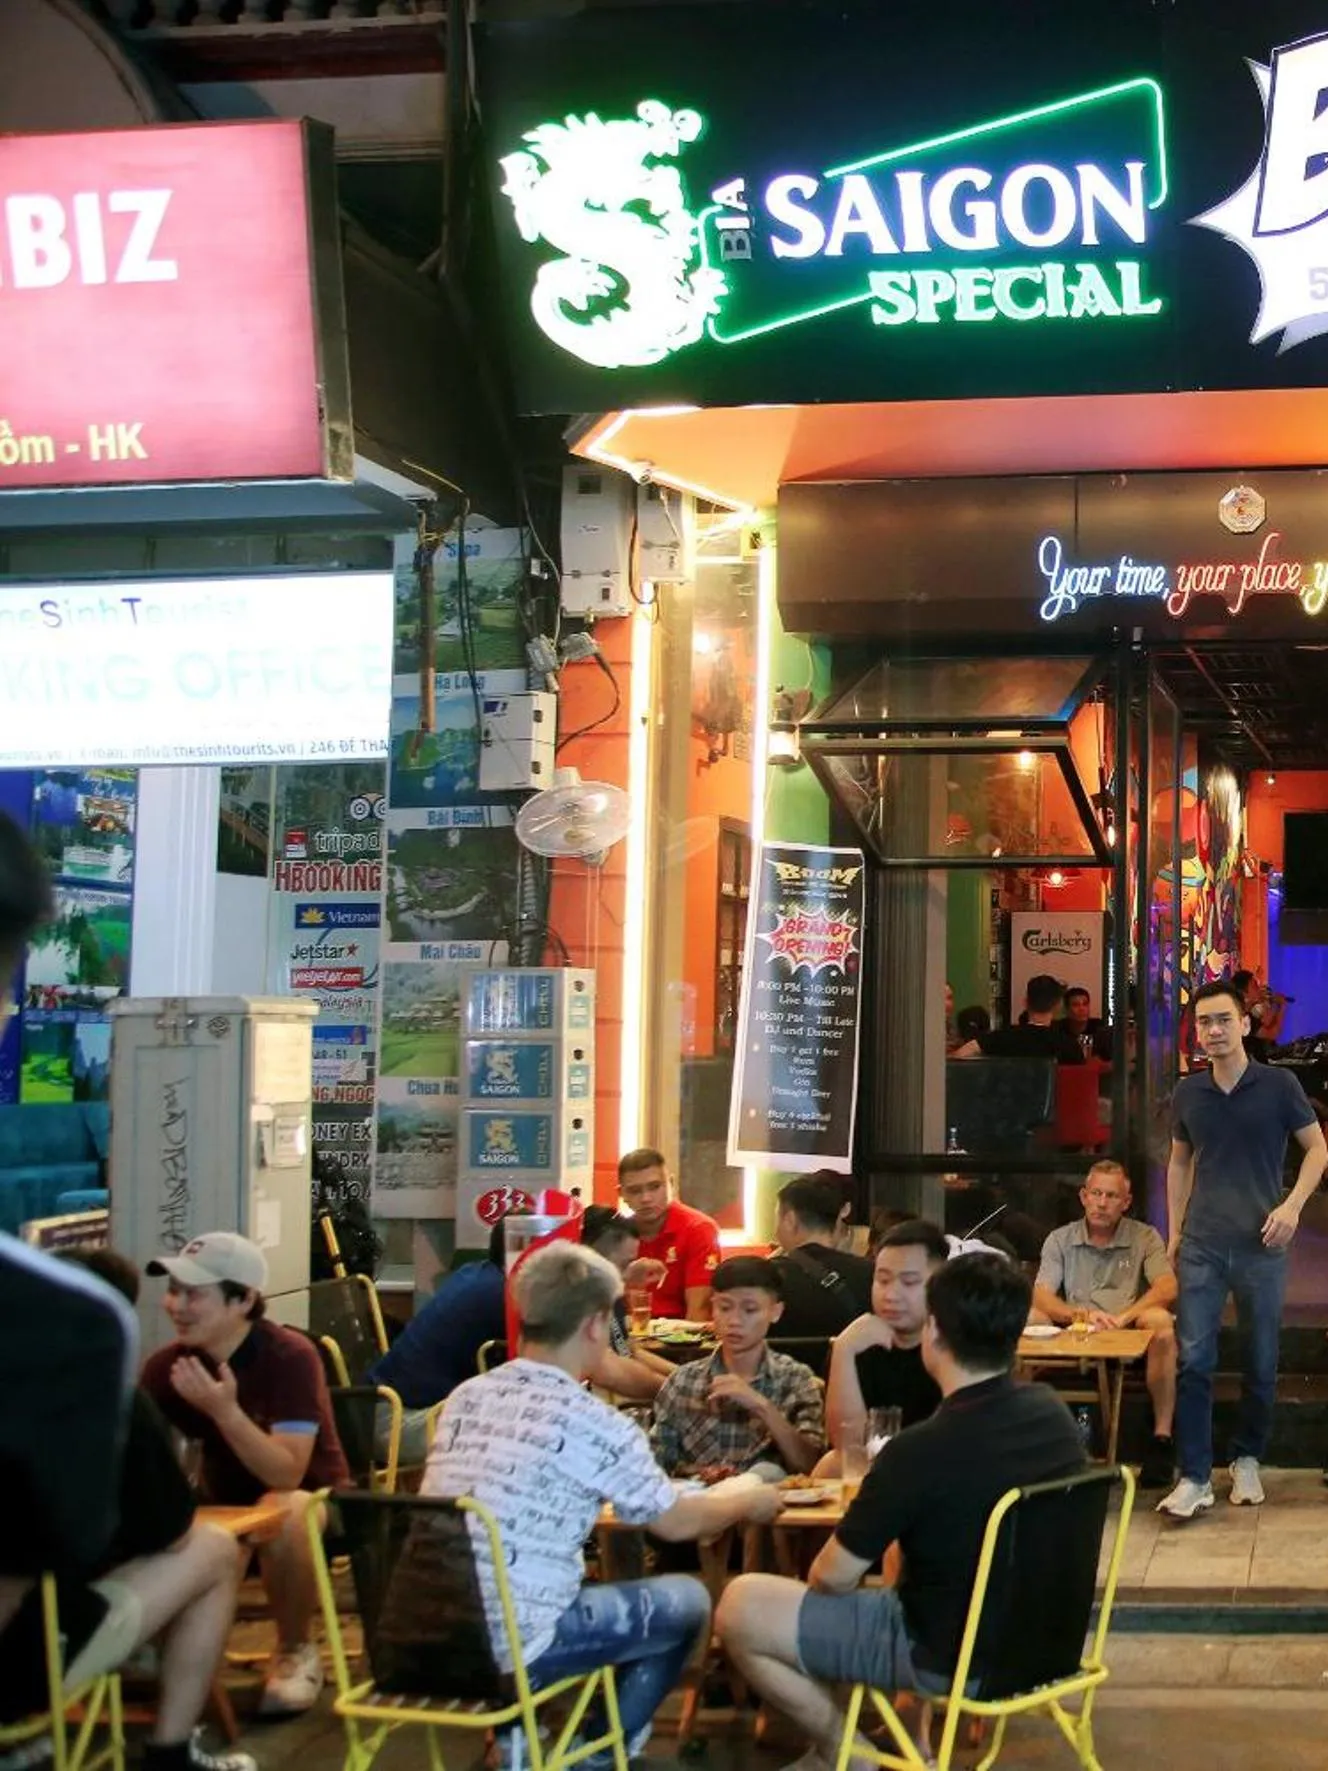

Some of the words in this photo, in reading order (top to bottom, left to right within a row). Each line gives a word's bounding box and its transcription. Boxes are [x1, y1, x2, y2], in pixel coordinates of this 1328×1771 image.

[711, 176, 753, 261] BIA
[765, 162, 1149, 260] SAIGON
[868, 261, 1163, 325] SPECIAL
[88, 423, 148, 463] HK
[1038, 537, 1110, 621] Your
[1167, 558, 1240, 615] your
[290, 943, 345, 960] Jetstar
[1022, 929, 1092, 955] Carlsberg
